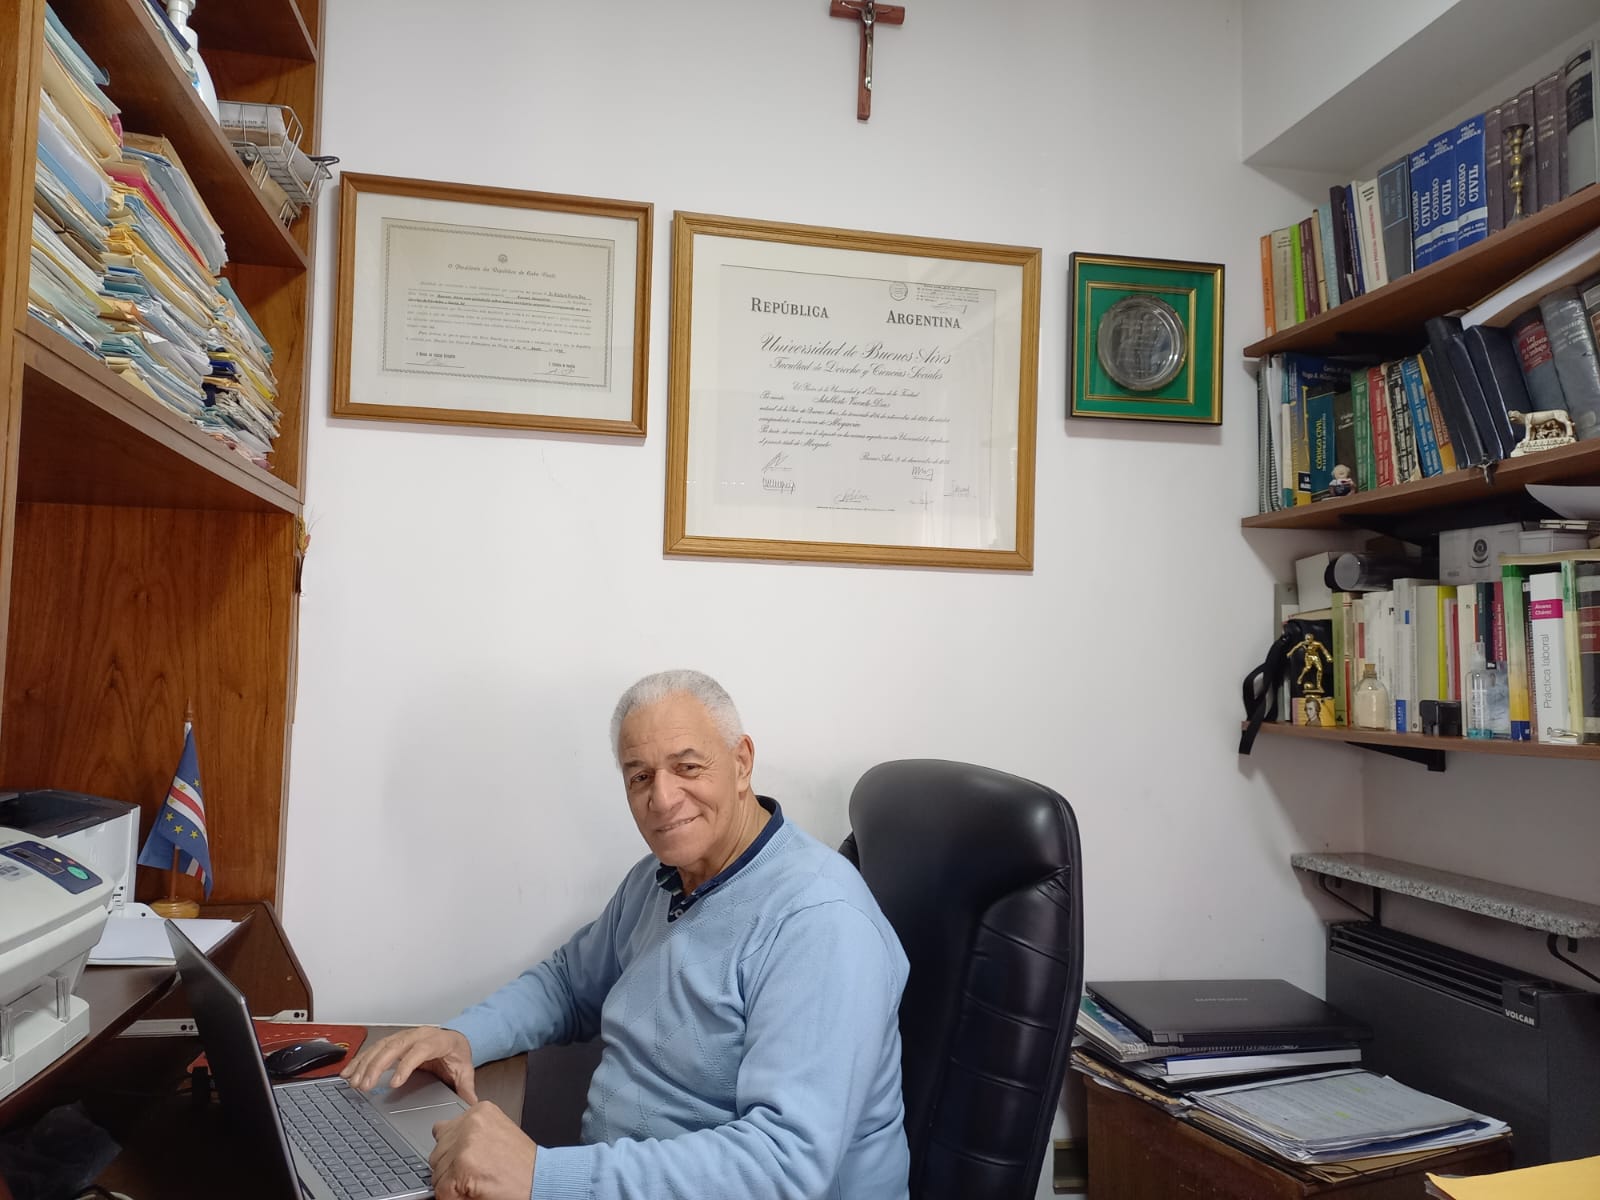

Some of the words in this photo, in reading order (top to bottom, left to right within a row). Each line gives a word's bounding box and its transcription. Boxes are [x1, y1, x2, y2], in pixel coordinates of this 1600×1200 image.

[1441, 179, 1452, 216] CIVIL
[1468, 164, 1479, 203] CIVIL
[1420, 192, 1431, 227] CIVIL
[886, 309, 962, 329] ARGENTINA
[760, 335, 847, 357] Universidad
[843, 345, 858, 358] de
[863, 341, 914, 362] Buenos
[915, 345, 952, 365] Aires
[1541, 633, 1551, 667] laboral
[1542, 667, 1553, 709] Práctica
[1505, 1009, 1535, 1026] VOLCAN
